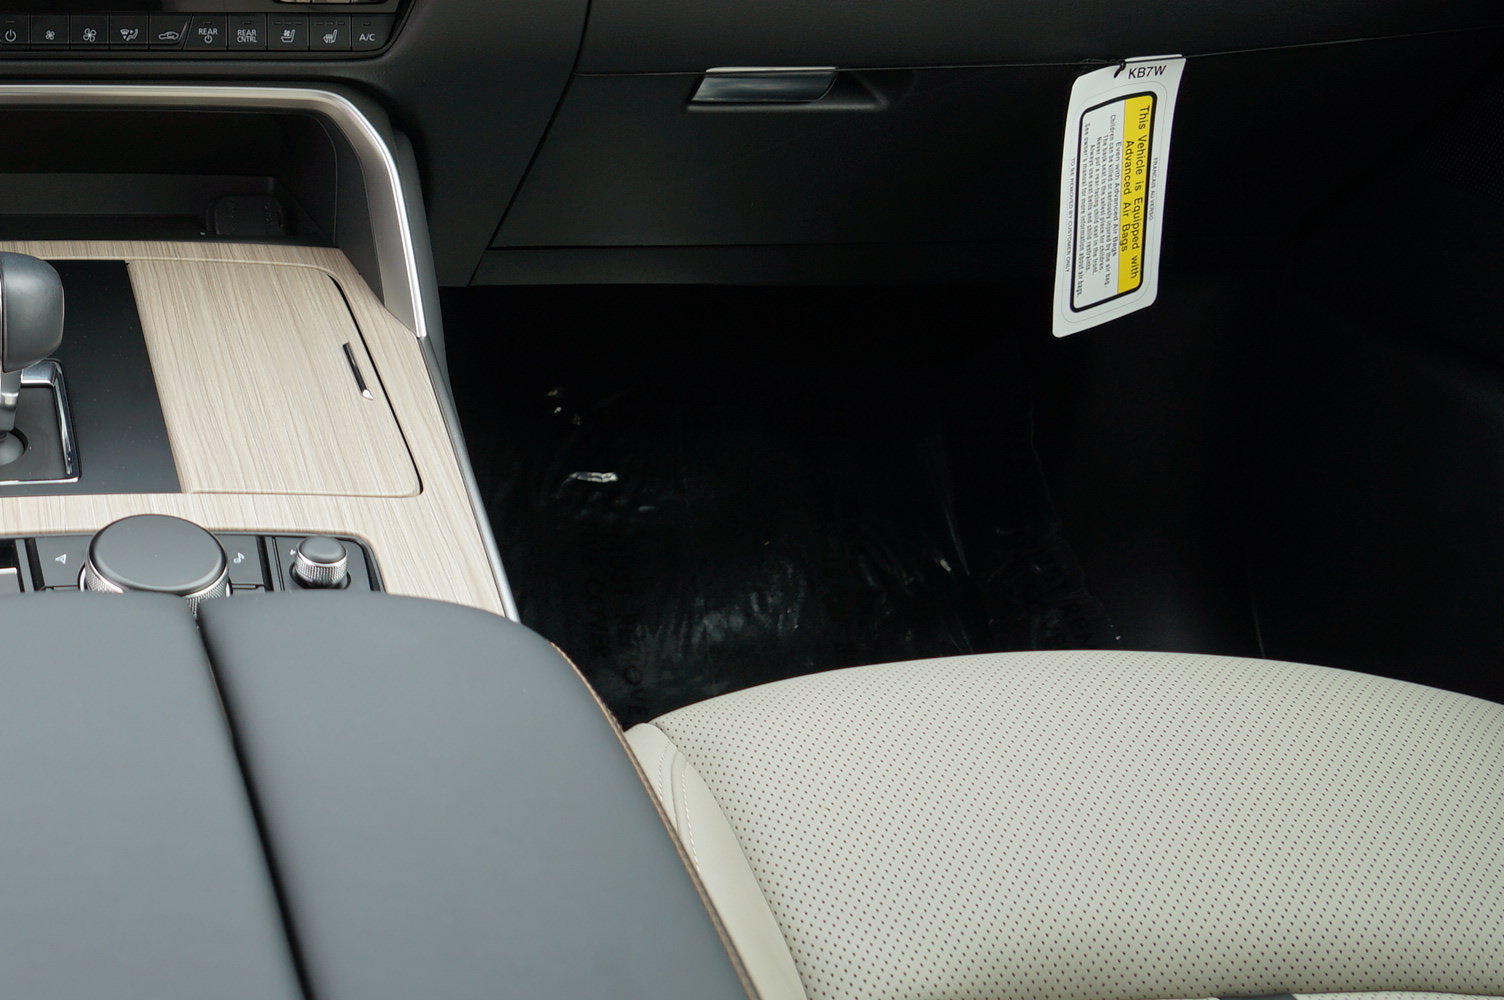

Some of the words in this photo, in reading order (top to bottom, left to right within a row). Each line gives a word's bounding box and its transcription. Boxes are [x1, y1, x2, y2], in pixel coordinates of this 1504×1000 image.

[198, 28, 218, 36] REAR
[237, 28, 257, 37] REAR
[359, 33, 375, 42] A/C
[1128, 65, 1167, 79] KB7W
[1138, 105, 1150, 130] This
[1136, 135, 1147, 175] Vehicle
[1124, 140, 1134, 195] Advanced
[1135, 181, 1144, 191] is
[1122, 202, 1131, 216] Air
[1131, 197, 1143, 250] Equipped
[1120, 224, 1130, 252] Bags
